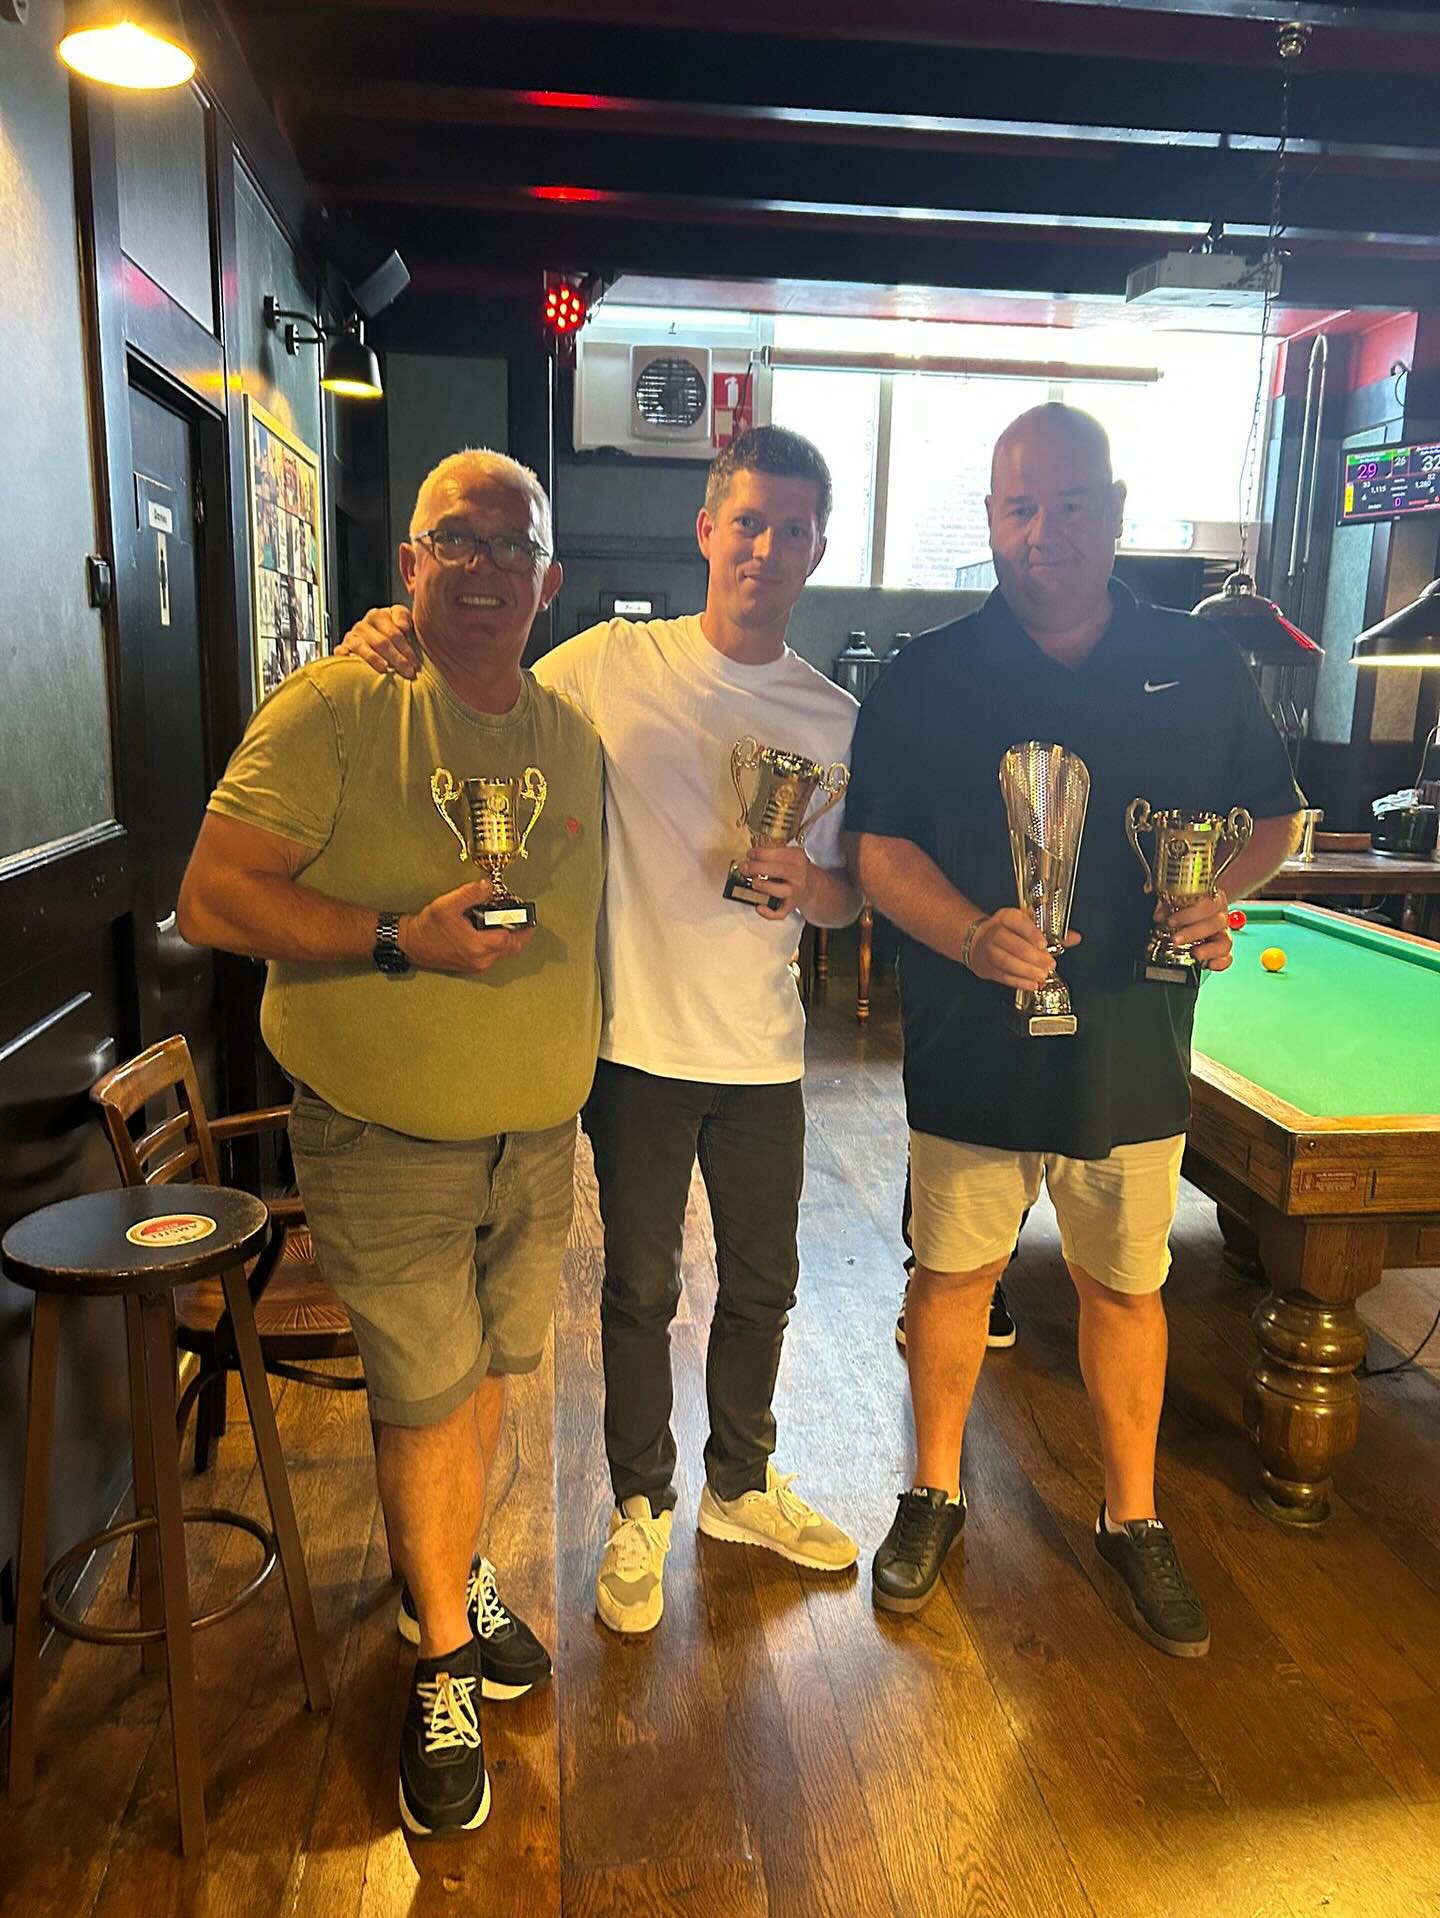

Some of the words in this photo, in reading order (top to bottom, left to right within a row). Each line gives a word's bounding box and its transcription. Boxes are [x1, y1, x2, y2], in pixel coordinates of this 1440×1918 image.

[1394, 456, 1406, 467] 26
[1422, 455, 1440, 472] 32
[1357, 463, 1377, 480] 29
[912, 1488, 928, 1497] FILA
